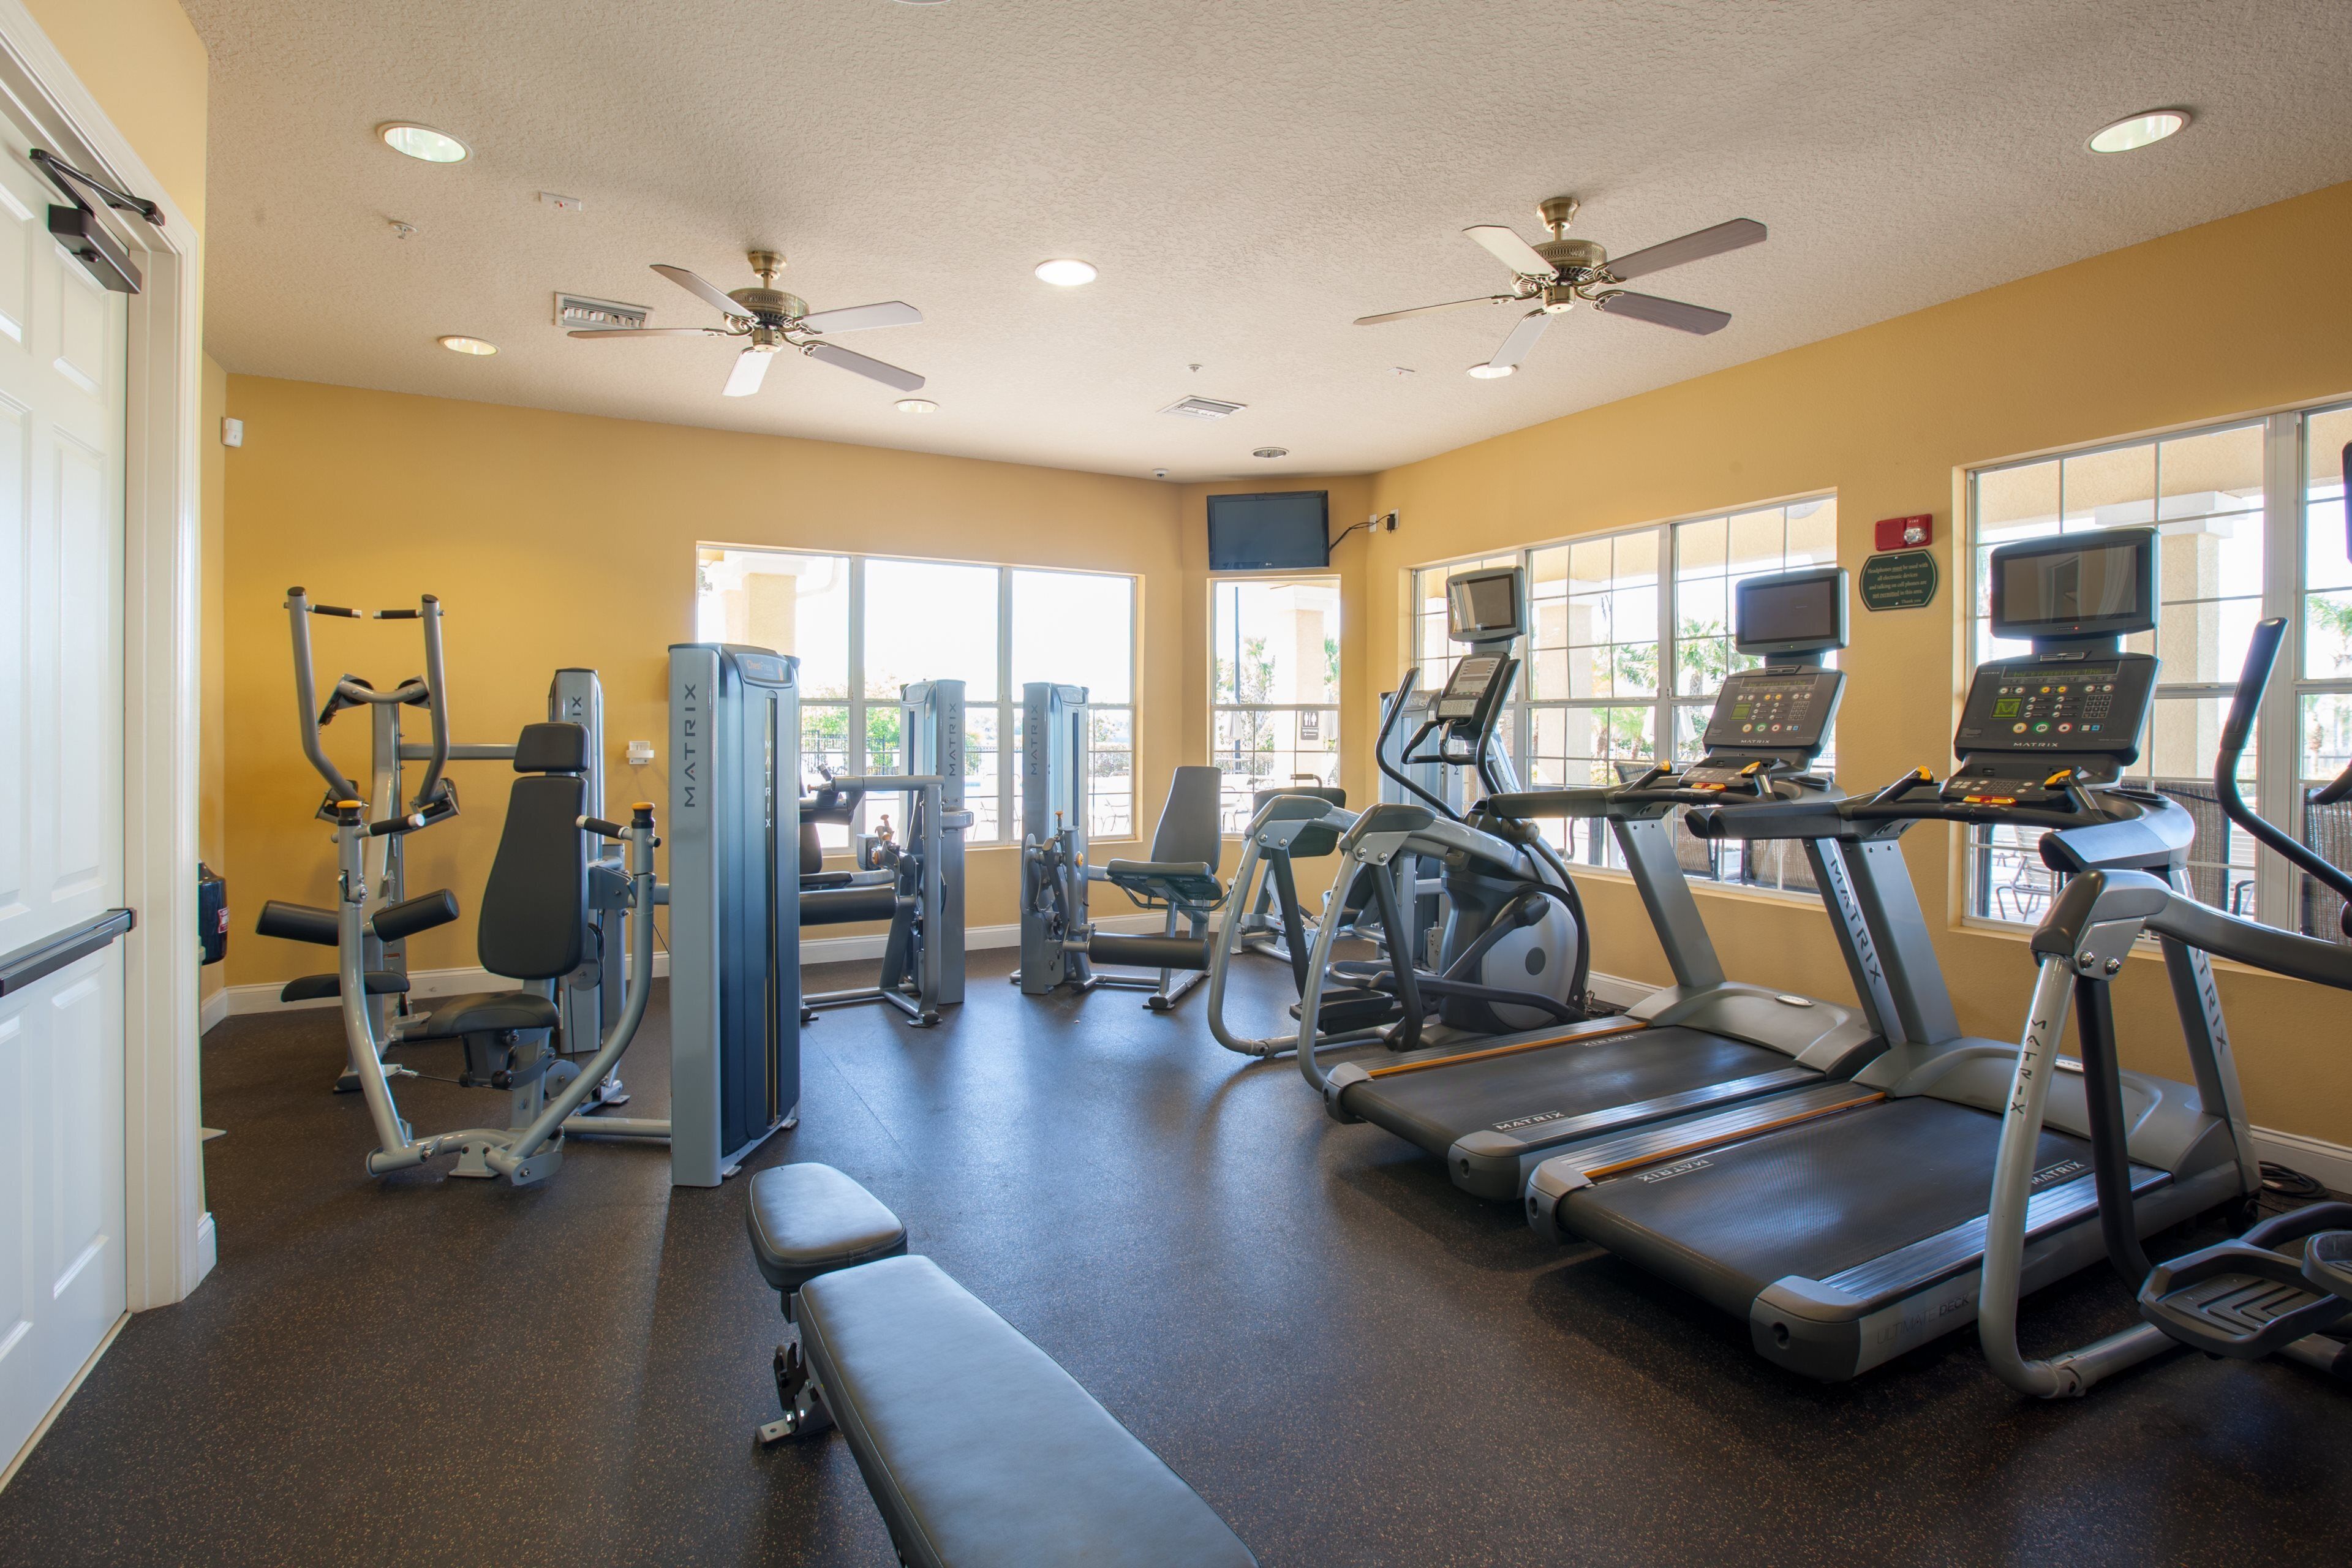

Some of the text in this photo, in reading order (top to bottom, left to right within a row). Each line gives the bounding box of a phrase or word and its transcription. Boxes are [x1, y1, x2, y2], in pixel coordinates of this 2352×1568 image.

[684, 684, 696, 807] MATRIX
[1831, 859, 1881, 985] MATRIX
[1580, 1035, 1635, 1046] MATRIX
[2010, 1019, 2047, 1114] MATRIX
[1496, 1112, 1565, 1130] MATRIX
[1638, 1159, 1709, 1182] MATRIX
[2032, 1161, 2084, 1185] MATRIX
[1877, 1293, 1970, 1344] ULTIMATE DECK
